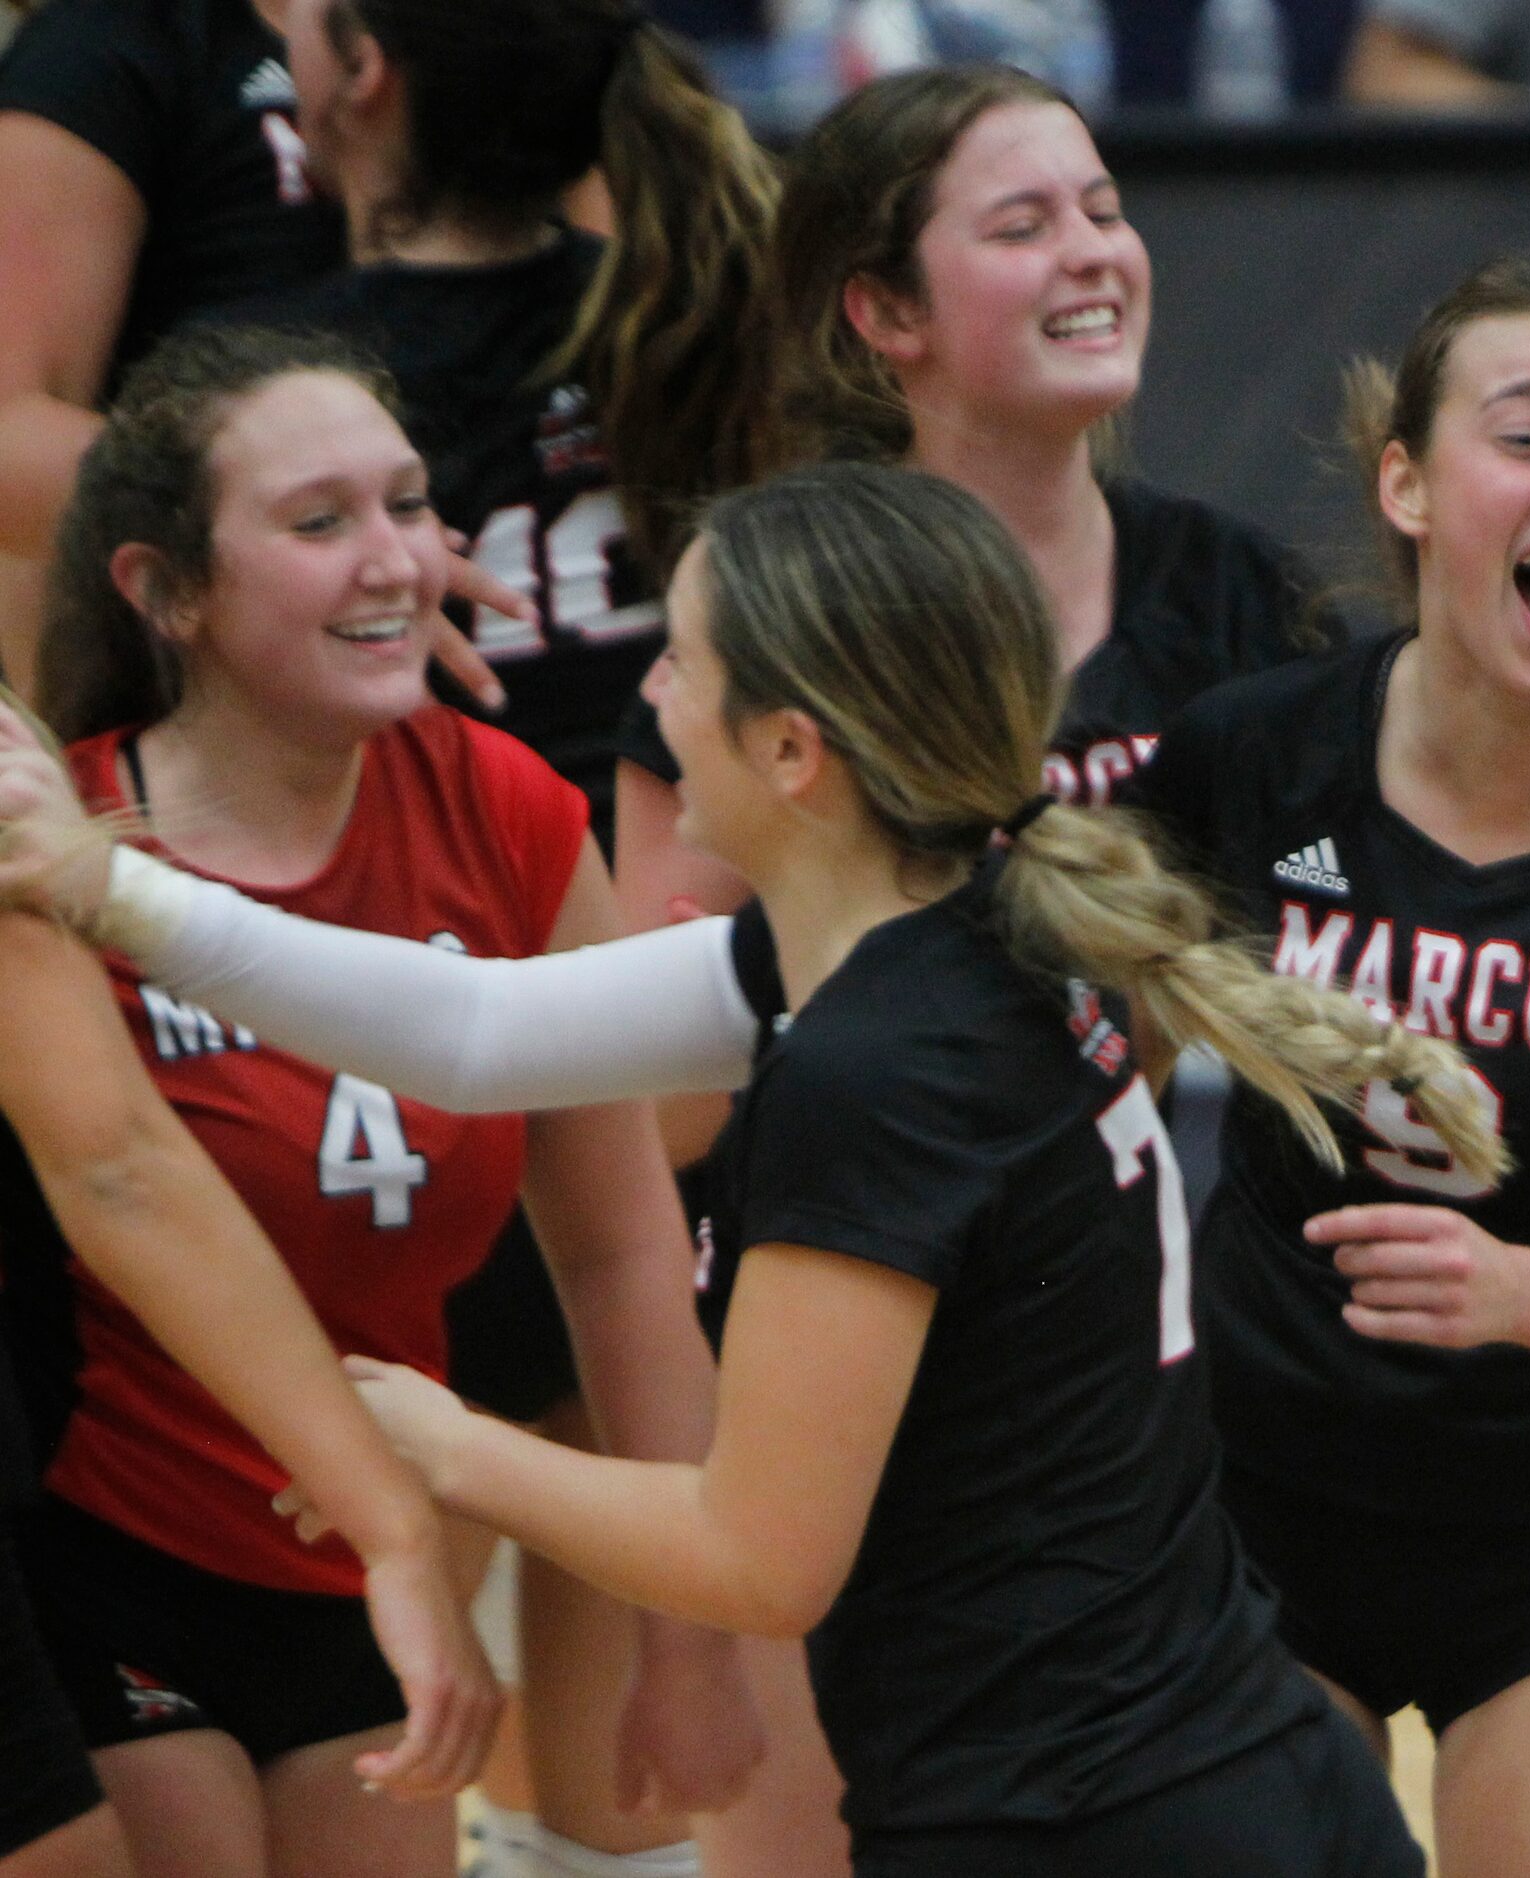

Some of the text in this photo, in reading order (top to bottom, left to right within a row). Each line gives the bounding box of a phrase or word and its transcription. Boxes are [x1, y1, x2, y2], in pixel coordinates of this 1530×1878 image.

[1273, 859, 1350, 893] adidas
[317, 1071, 428, 1229] 4
[1094, 1072, 1196, 1367] 7
